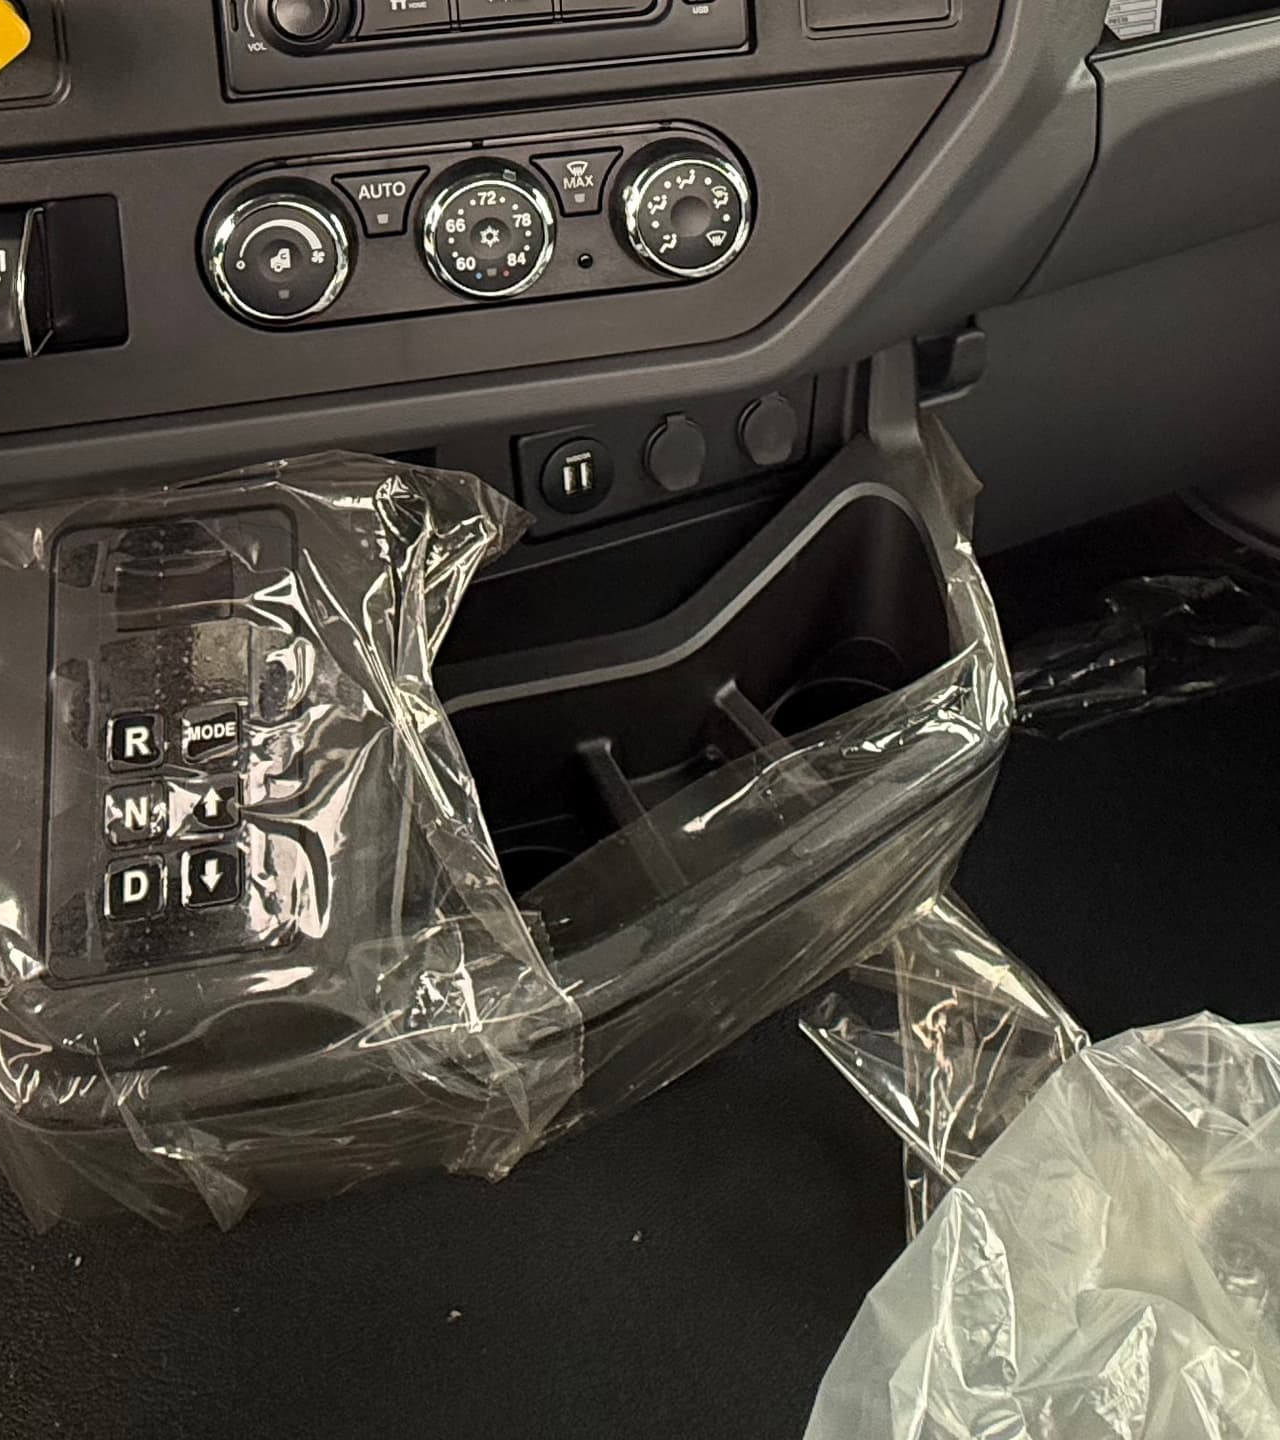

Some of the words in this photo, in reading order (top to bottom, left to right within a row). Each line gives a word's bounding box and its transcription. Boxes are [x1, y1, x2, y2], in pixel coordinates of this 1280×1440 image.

[248, 42, 266, 52] VOL
[563, 174, 594, 190] MAX
[358, 180, 407, 202] AUTO
[477, 190, 498, 206] 72
[445, 217, 466, 233] 66
[512, 213, 532, 229] 78
[455, 256, 476, 271] 60
[507, 251, 527, 266] 84
[188, 722, 236, 740] MODE
[125, 726, 151, 758] R
[124, 797, 149, 828] N
[122, 869, 149, 904] D
